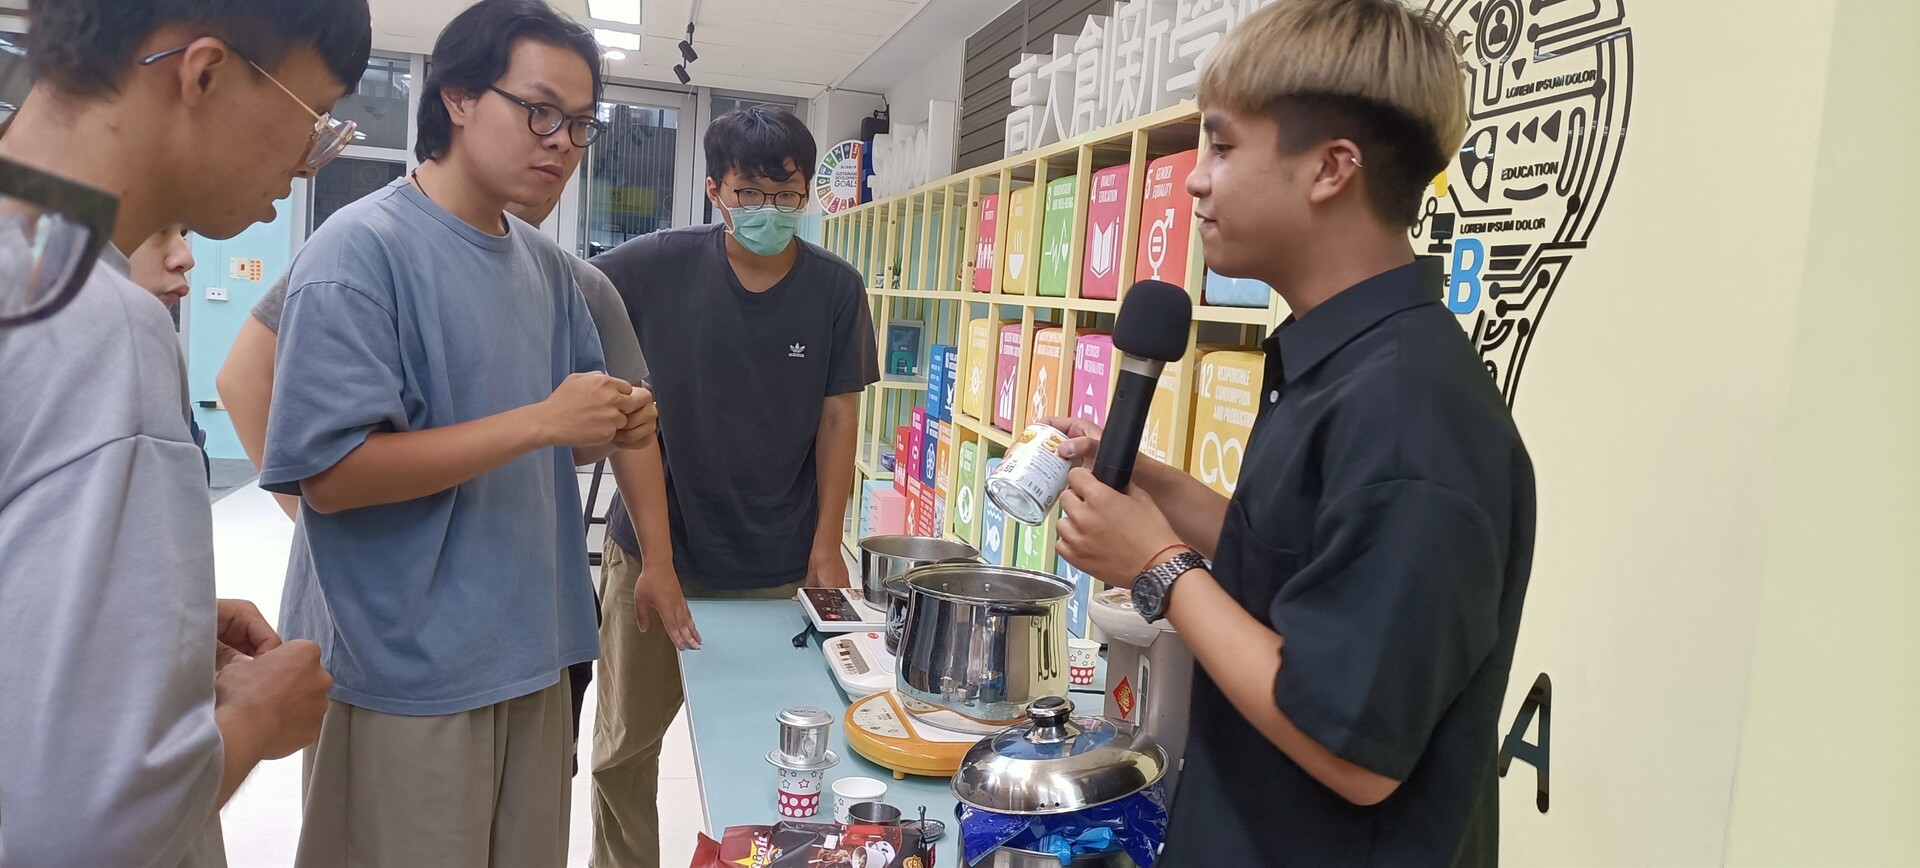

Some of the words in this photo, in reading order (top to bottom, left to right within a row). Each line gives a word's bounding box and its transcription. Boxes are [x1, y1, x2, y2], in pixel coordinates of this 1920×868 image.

[1004, 0, 1263, 159] 高大創新學
[1506, 82, 1534, 99] LOREM
[1535, 76, 1565, 92] IPSUM
[1566, 69, 1597, 85] DOLOR
[1145, 169, 1153, 200] 5
[1501, 161, 1559, 181] EDUCATION
[1091, 176, 1098, 204] 4
[1460, 223, 1486, 234] LOREM
[1487, 220, 1514, 233] IPSUM
[1515, 218, 1546, 231] DOLOR
[1448, 238, 1485, 314] B
[1201, 363, 1213, 398] 12
[1498, 672, 1552, 814] A
